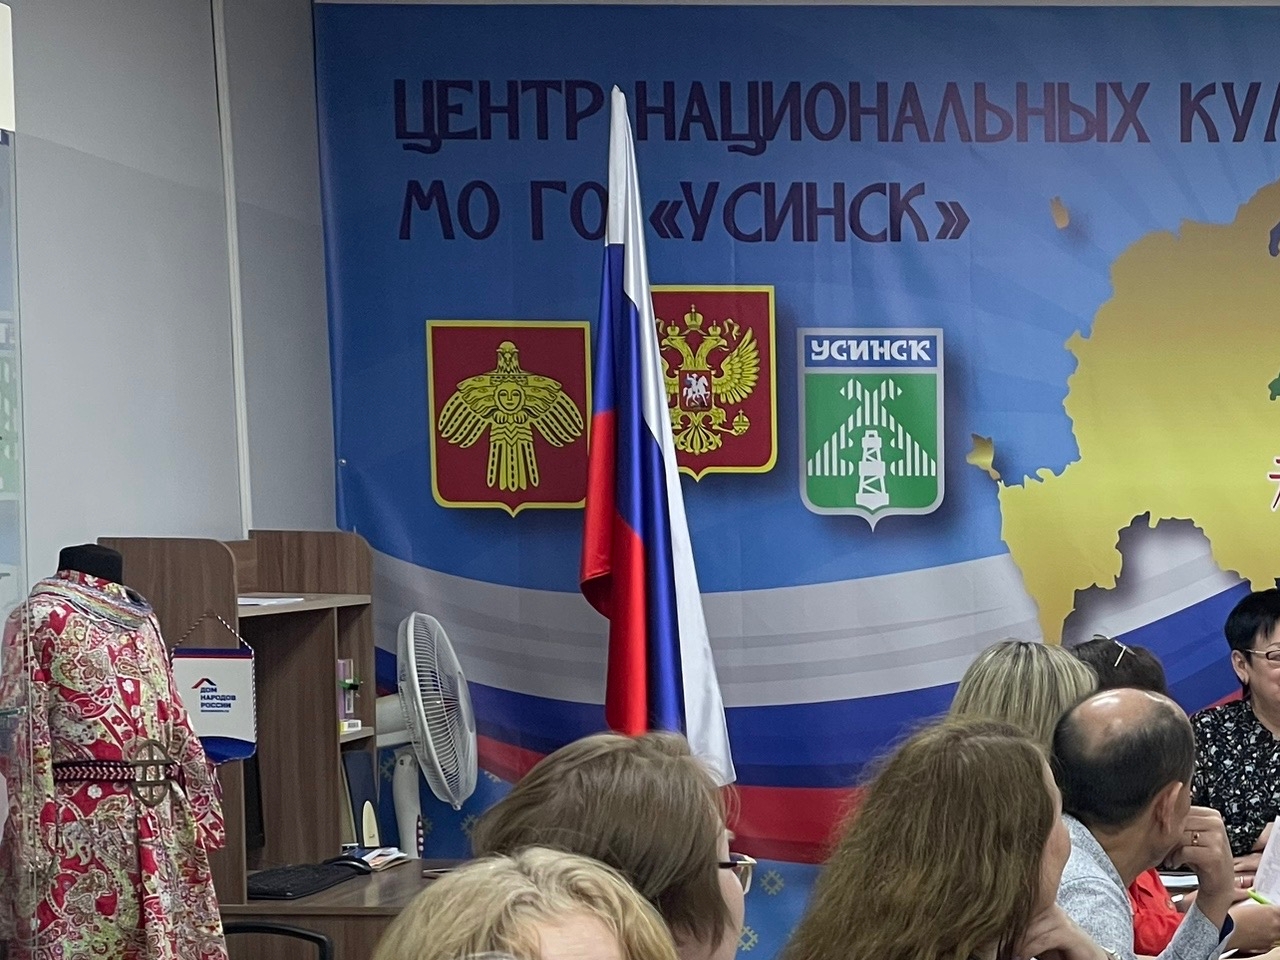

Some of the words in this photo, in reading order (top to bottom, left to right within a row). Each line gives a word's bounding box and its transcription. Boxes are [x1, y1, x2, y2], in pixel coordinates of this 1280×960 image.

[394, 78, 605, 154] ЦЕНТР
[634, 80, 1151, 156] НАЦИОНАЛЬНЫХ
[399, 179, 500, 241] МО
[529, 180, 609, 241] ГО
[648, 181, 971, 243] «УСИНСК»
[811, 339, 931, 361] УСИНСК
